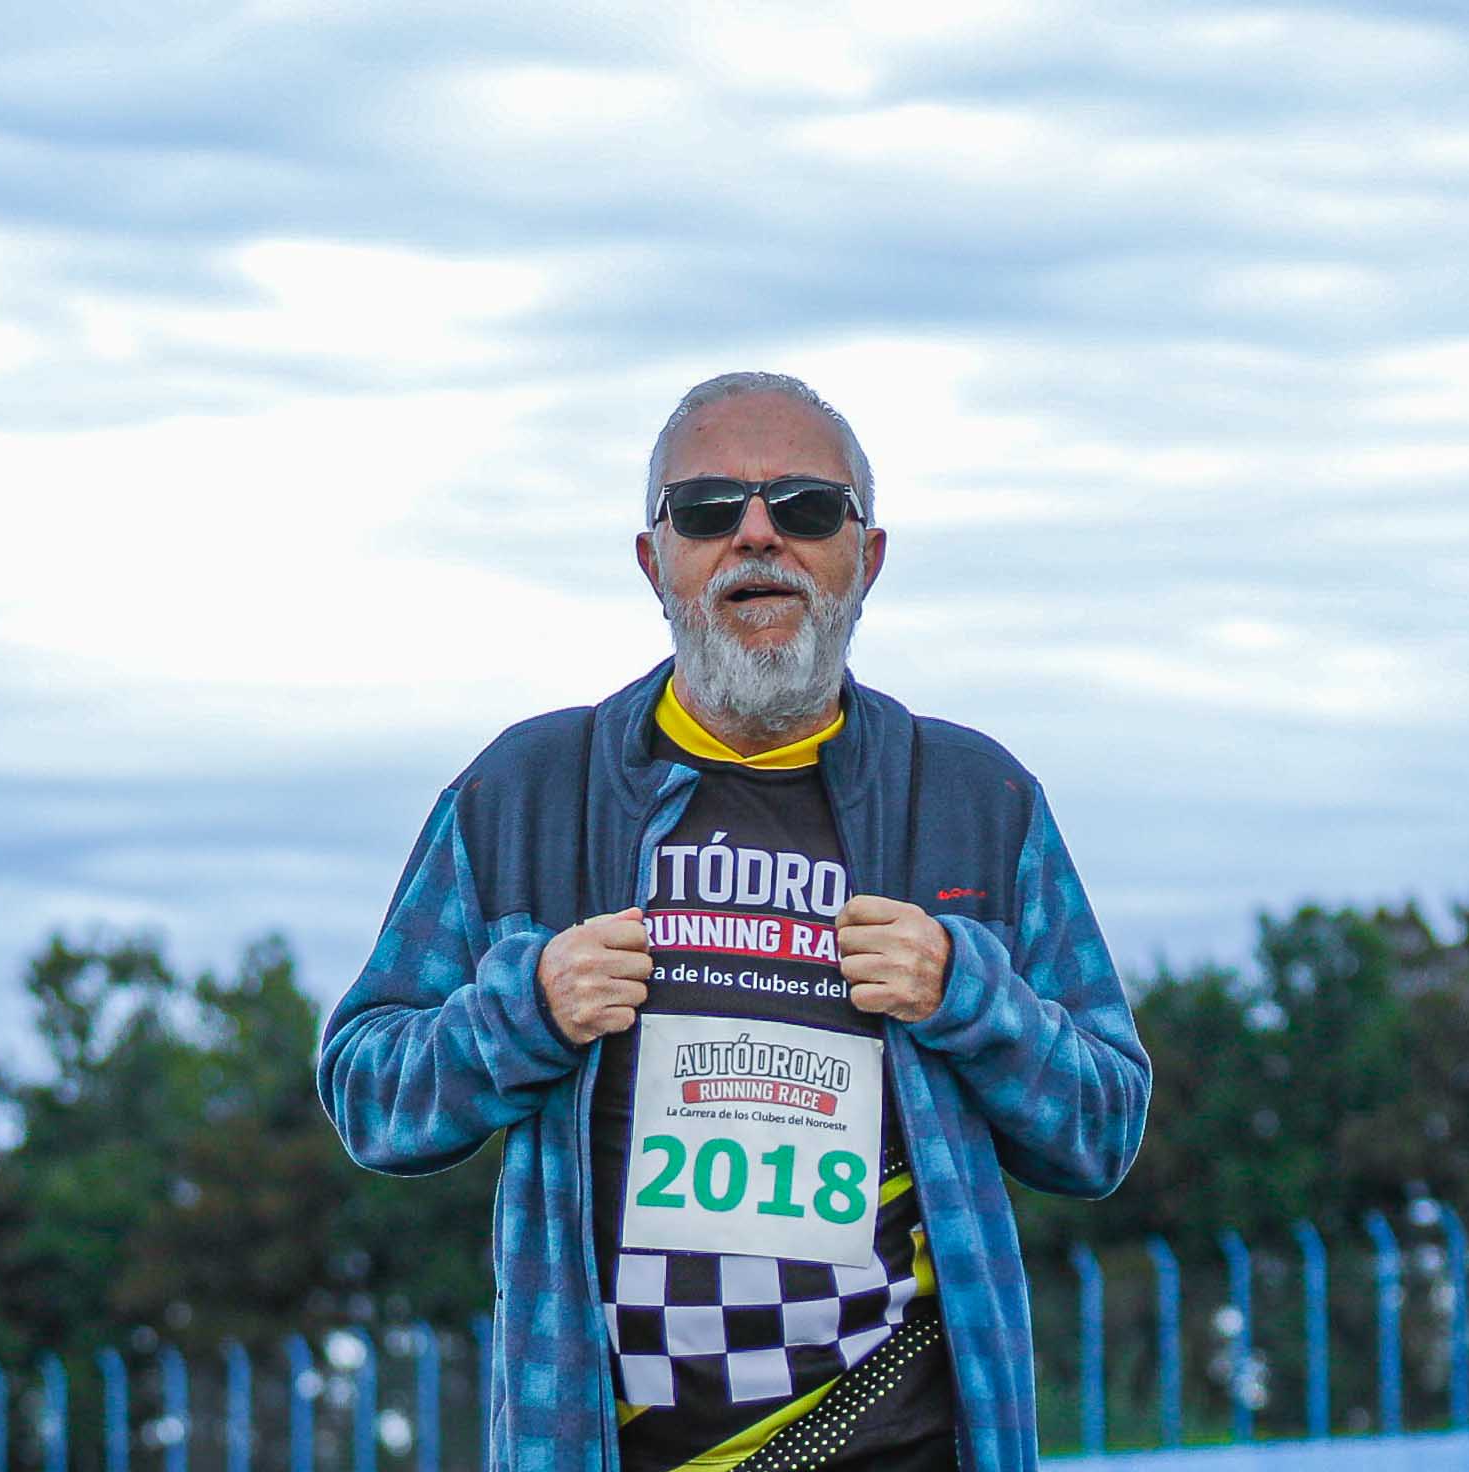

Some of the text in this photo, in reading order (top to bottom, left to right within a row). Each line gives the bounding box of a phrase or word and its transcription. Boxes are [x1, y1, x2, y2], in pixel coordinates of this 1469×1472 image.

[648, 831, 852, 917] TÓDRO
[790, 923, 842, 962] RA
[671, 963, 698, 983] de
[703, 966, 733, 986] los
[738, 971, 810, 995] Clubes
[815, 977, 847, 998] del
[674, 1033, 851, 1092] AUTÓDROMO
[699, 1082, 822, 1110] RUNNING RACE
[666, 1107, 848, 1131] La Carrera de los Clubes del Noroeste
[636, 1135, 867, 1225] 2018
